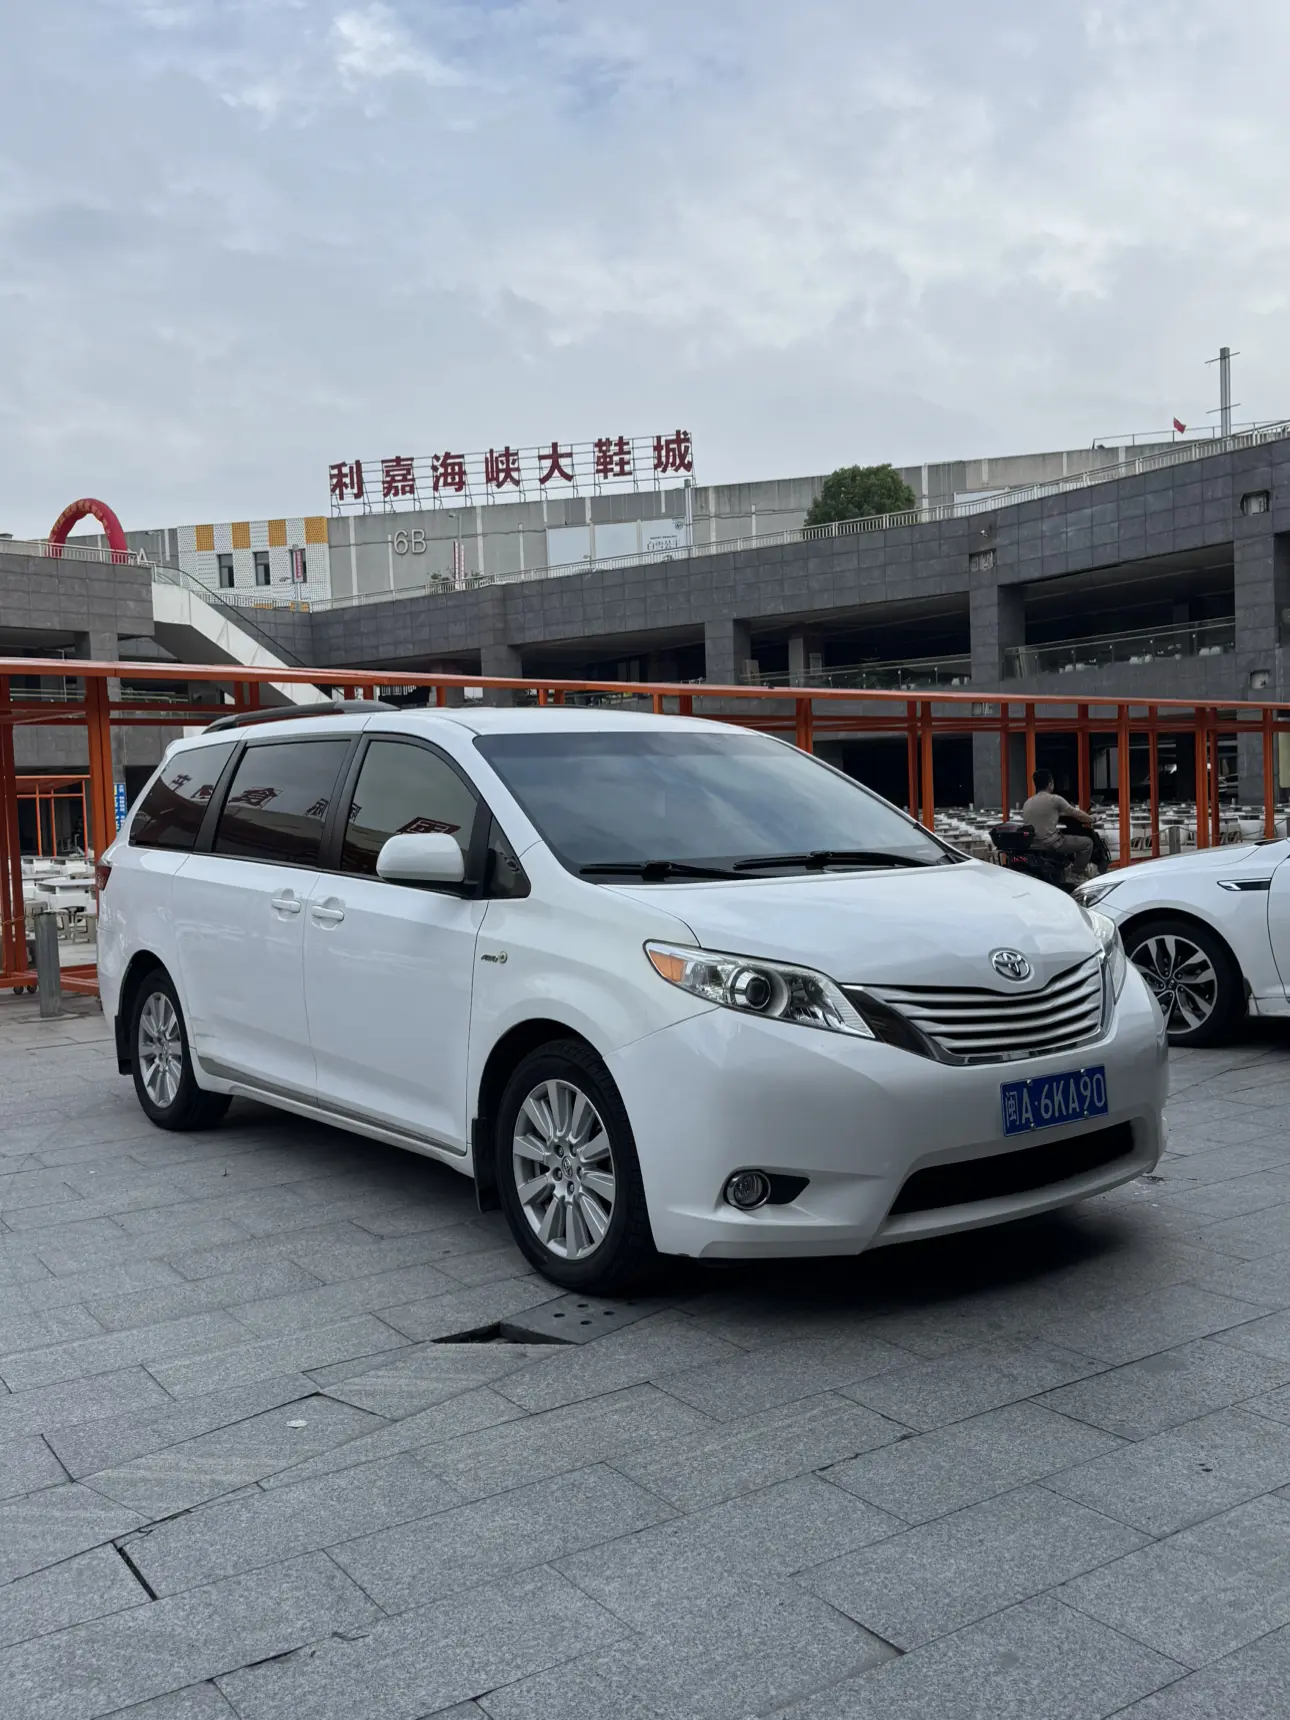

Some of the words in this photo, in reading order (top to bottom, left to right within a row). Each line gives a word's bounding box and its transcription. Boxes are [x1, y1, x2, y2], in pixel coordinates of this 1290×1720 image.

[330, 430, 693, 501] 利嘉海峡大鞋城
[393, 529, 427, 555] 6B
